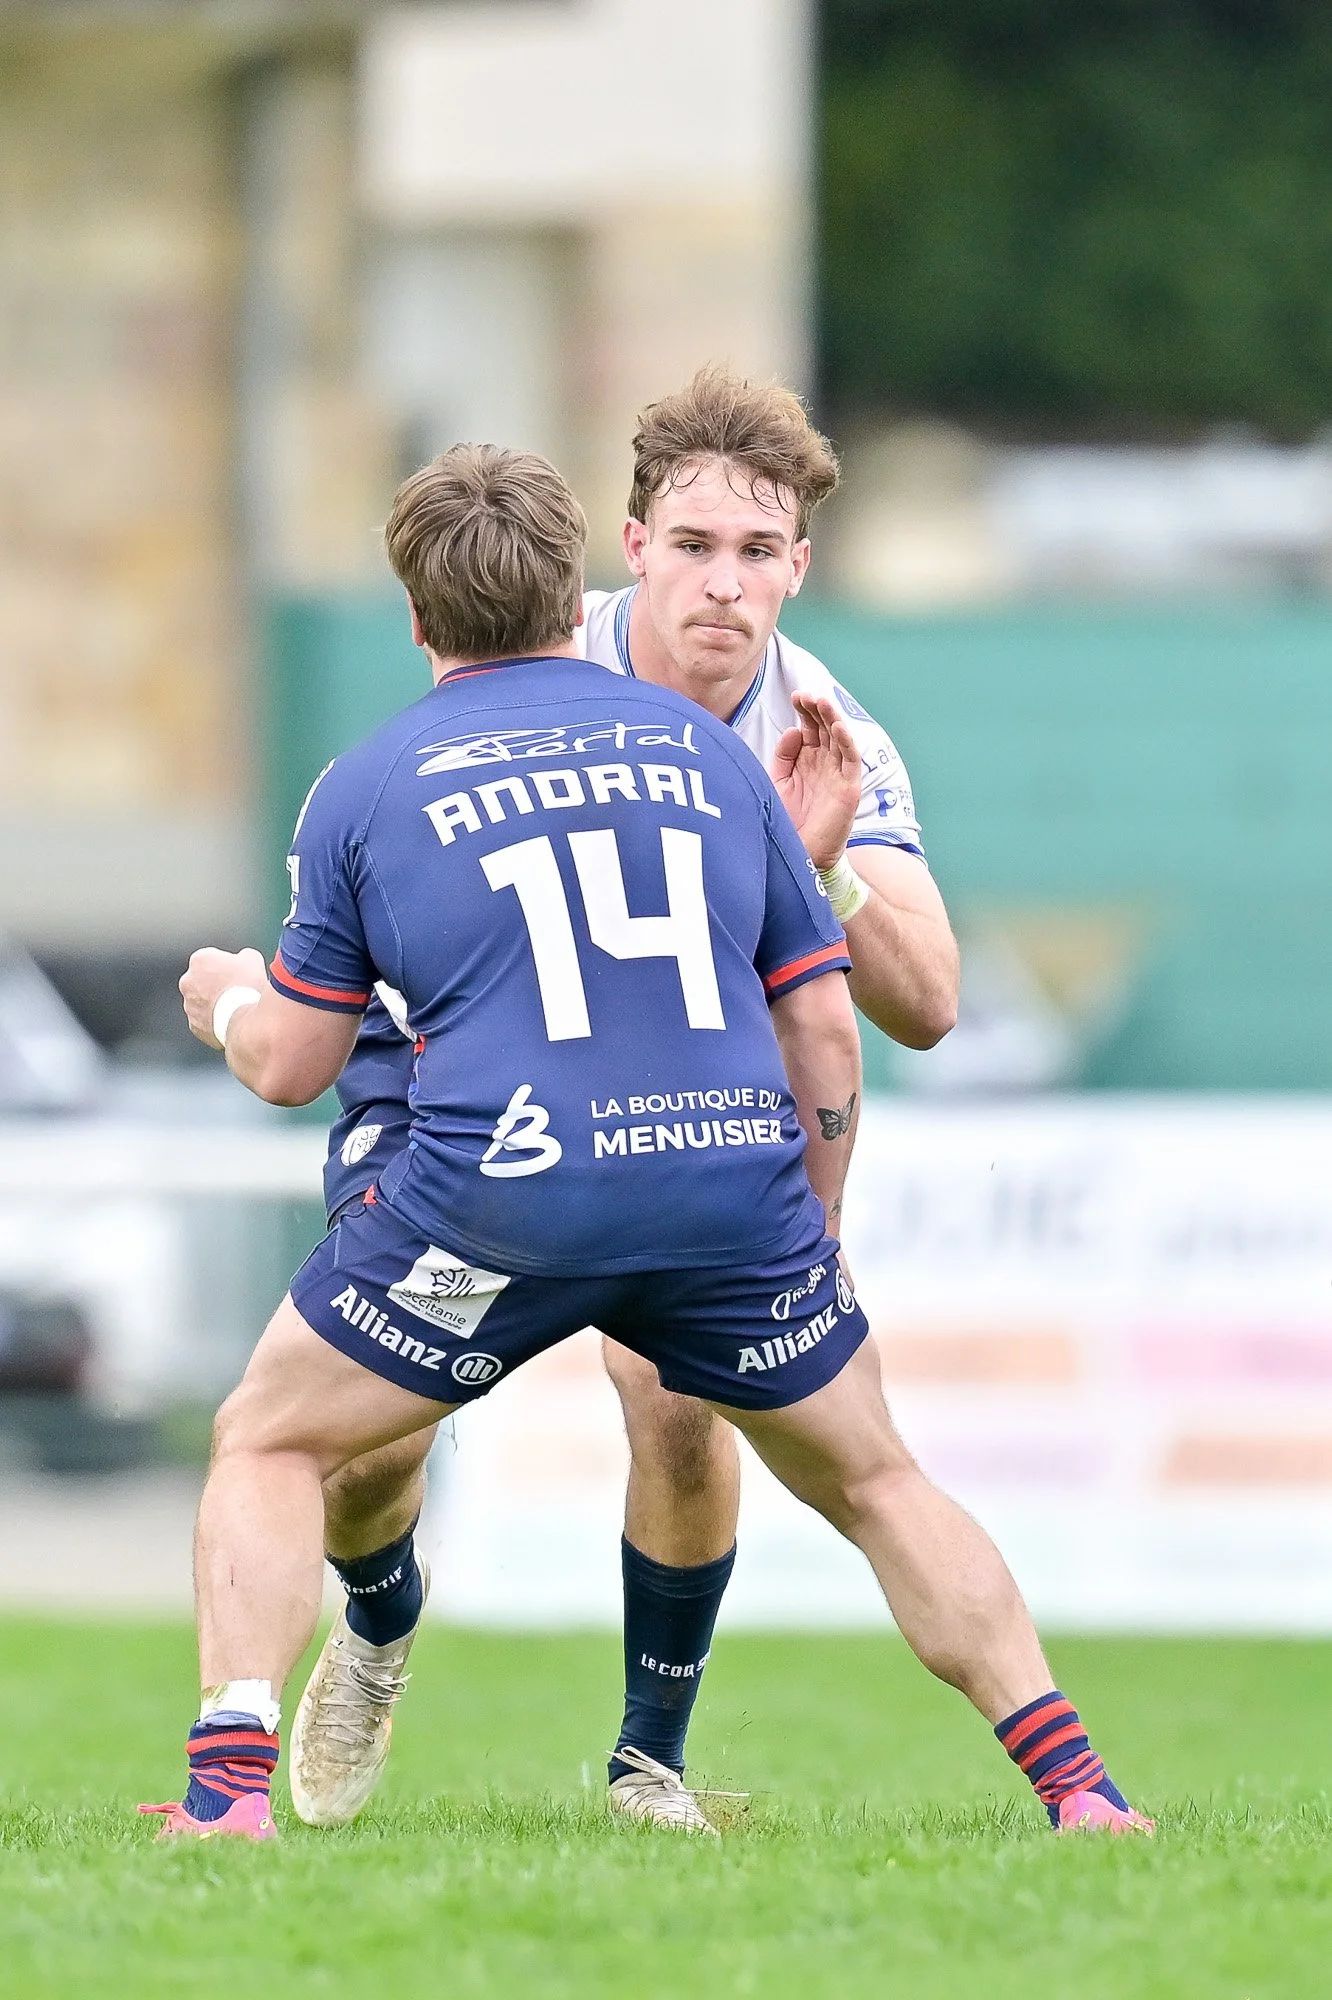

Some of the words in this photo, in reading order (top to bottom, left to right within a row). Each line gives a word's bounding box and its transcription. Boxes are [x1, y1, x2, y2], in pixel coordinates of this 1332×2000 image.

[421, 763, 721, 847] ANDRAL
[478, 826, 726, 1042] 14
[590, 1098, 623, 1120] LA
[627, 1087, 755, 1116] BOUTIQUE
[758, 1087, 782, 1112] DU
[593, 1118, 785, 1159] MENUISIER
[329, 1283, 448, 1371] Allianz
[737, 1302, 839, 1374] Allianz
[641, 1653, 657, 1671] LE
[658, 1662, 695, 1678] COQ
